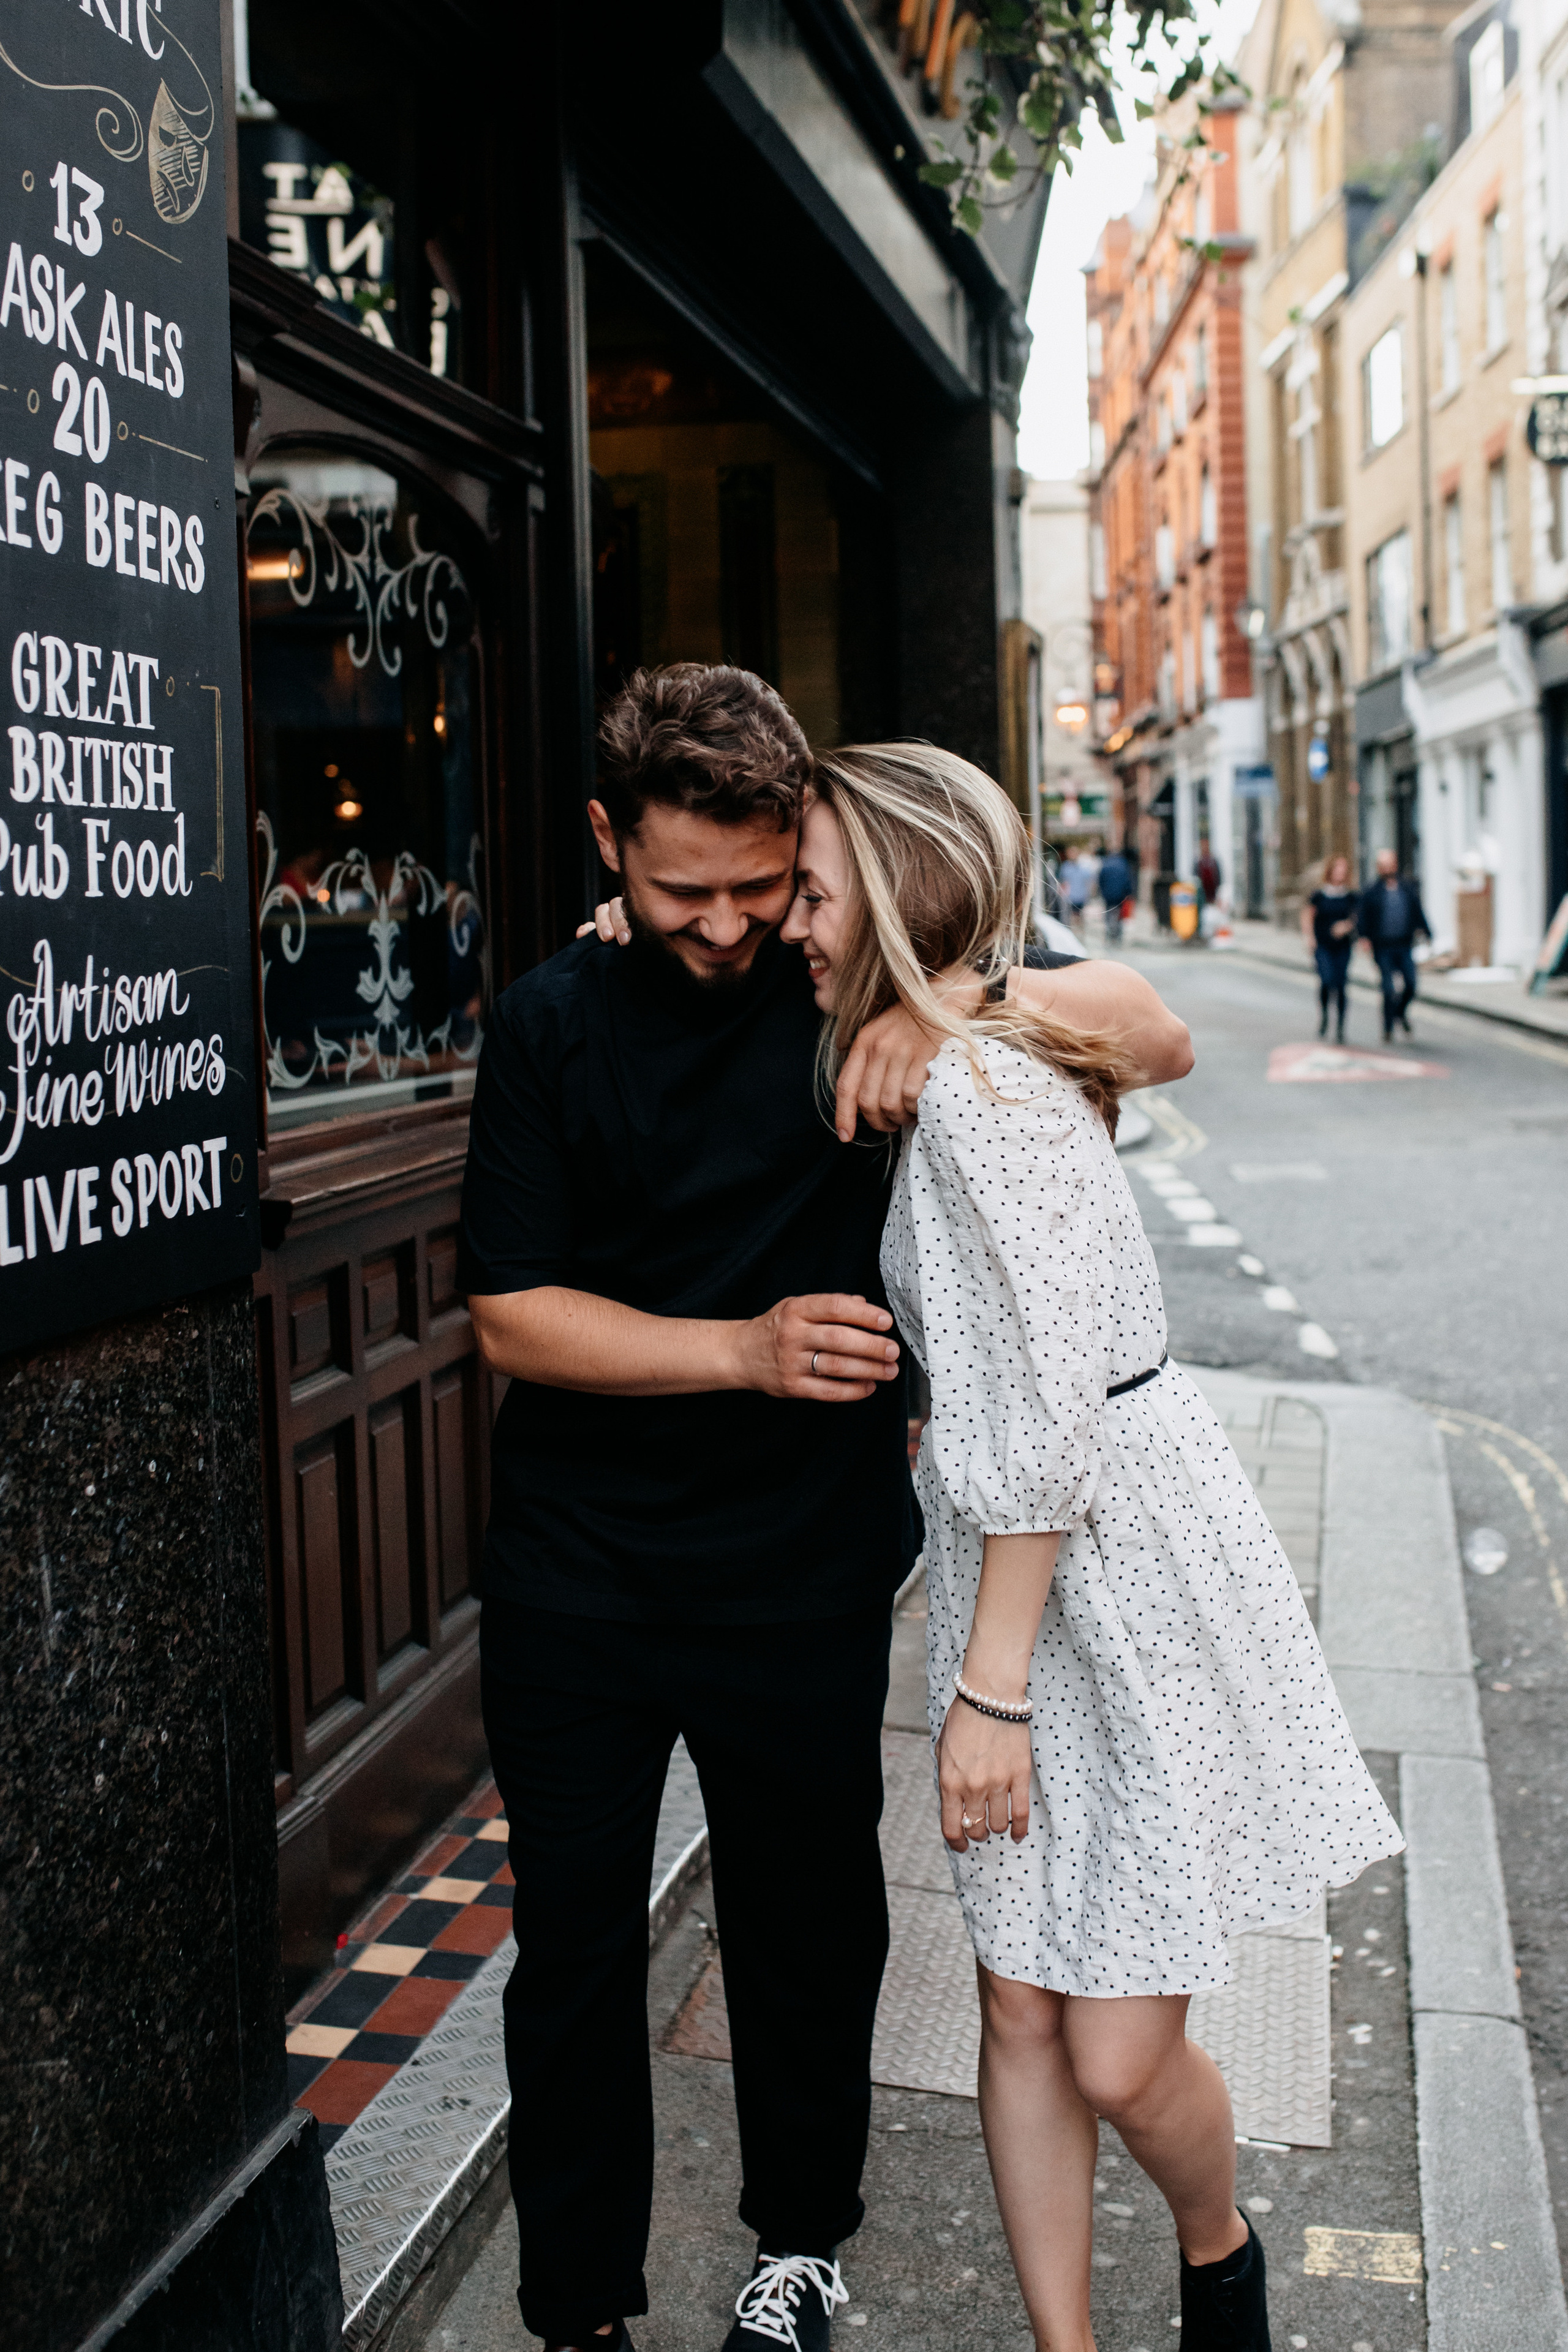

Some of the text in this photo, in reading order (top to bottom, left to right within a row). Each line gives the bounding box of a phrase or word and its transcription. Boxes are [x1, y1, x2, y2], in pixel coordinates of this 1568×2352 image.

[50, 161, 105, 257] 13
[0, 242, 184, 398] ASK ALES
[52, 361, 111, 464] 20
[0, 458, 205, 594] EG BEERS
[11, 630, 159, 730] GREAT
[7, 725, 176, 812] BRITISH
[81, 812, 193, 899] Food
[7, 938, 190, 1047] Artisan
[104, 1033, 226, 1117] Wines
[0, 1136, 227, 1267] LIVE SPORT
